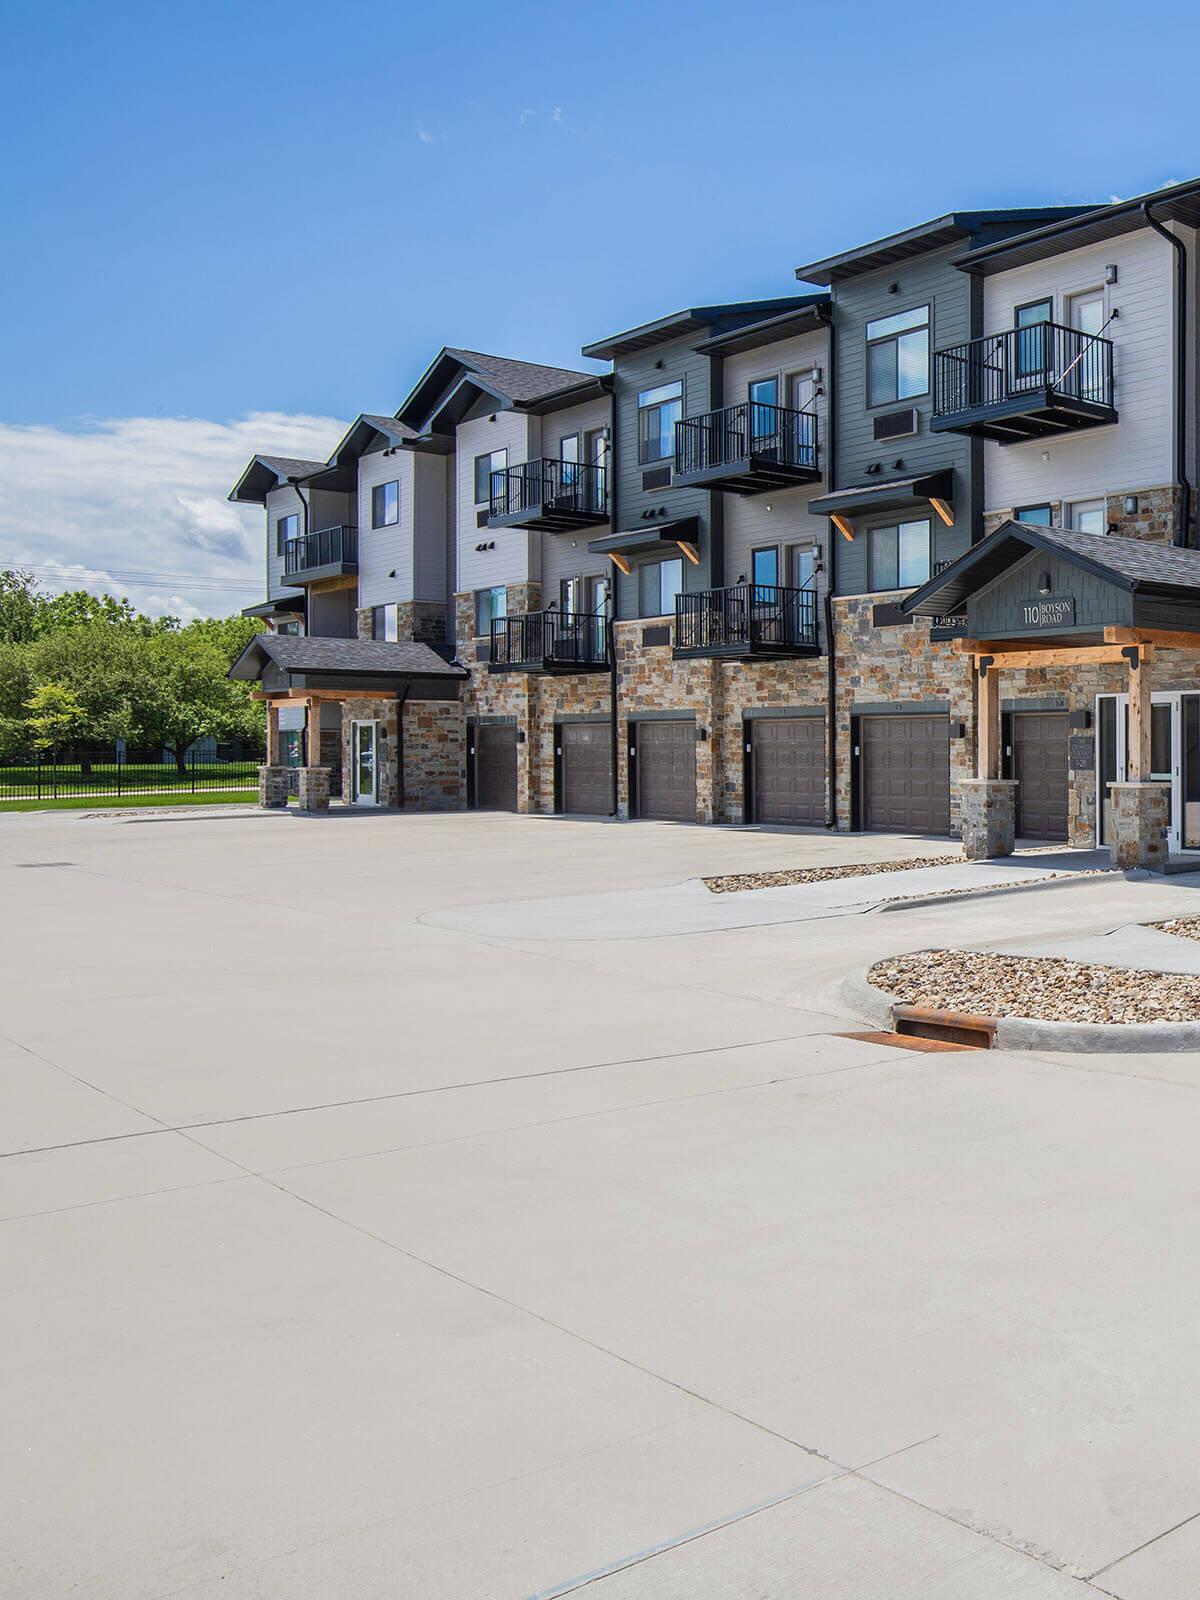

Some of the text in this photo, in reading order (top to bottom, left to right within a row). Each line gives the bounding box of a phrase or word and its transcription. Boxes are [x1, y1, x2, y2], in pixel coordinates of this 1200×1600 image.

[1041, 601, 1071, 614] BOYSON
[1023, 606, 1039, 624] 110
[1041, 613, 1063, 625] ROAD
